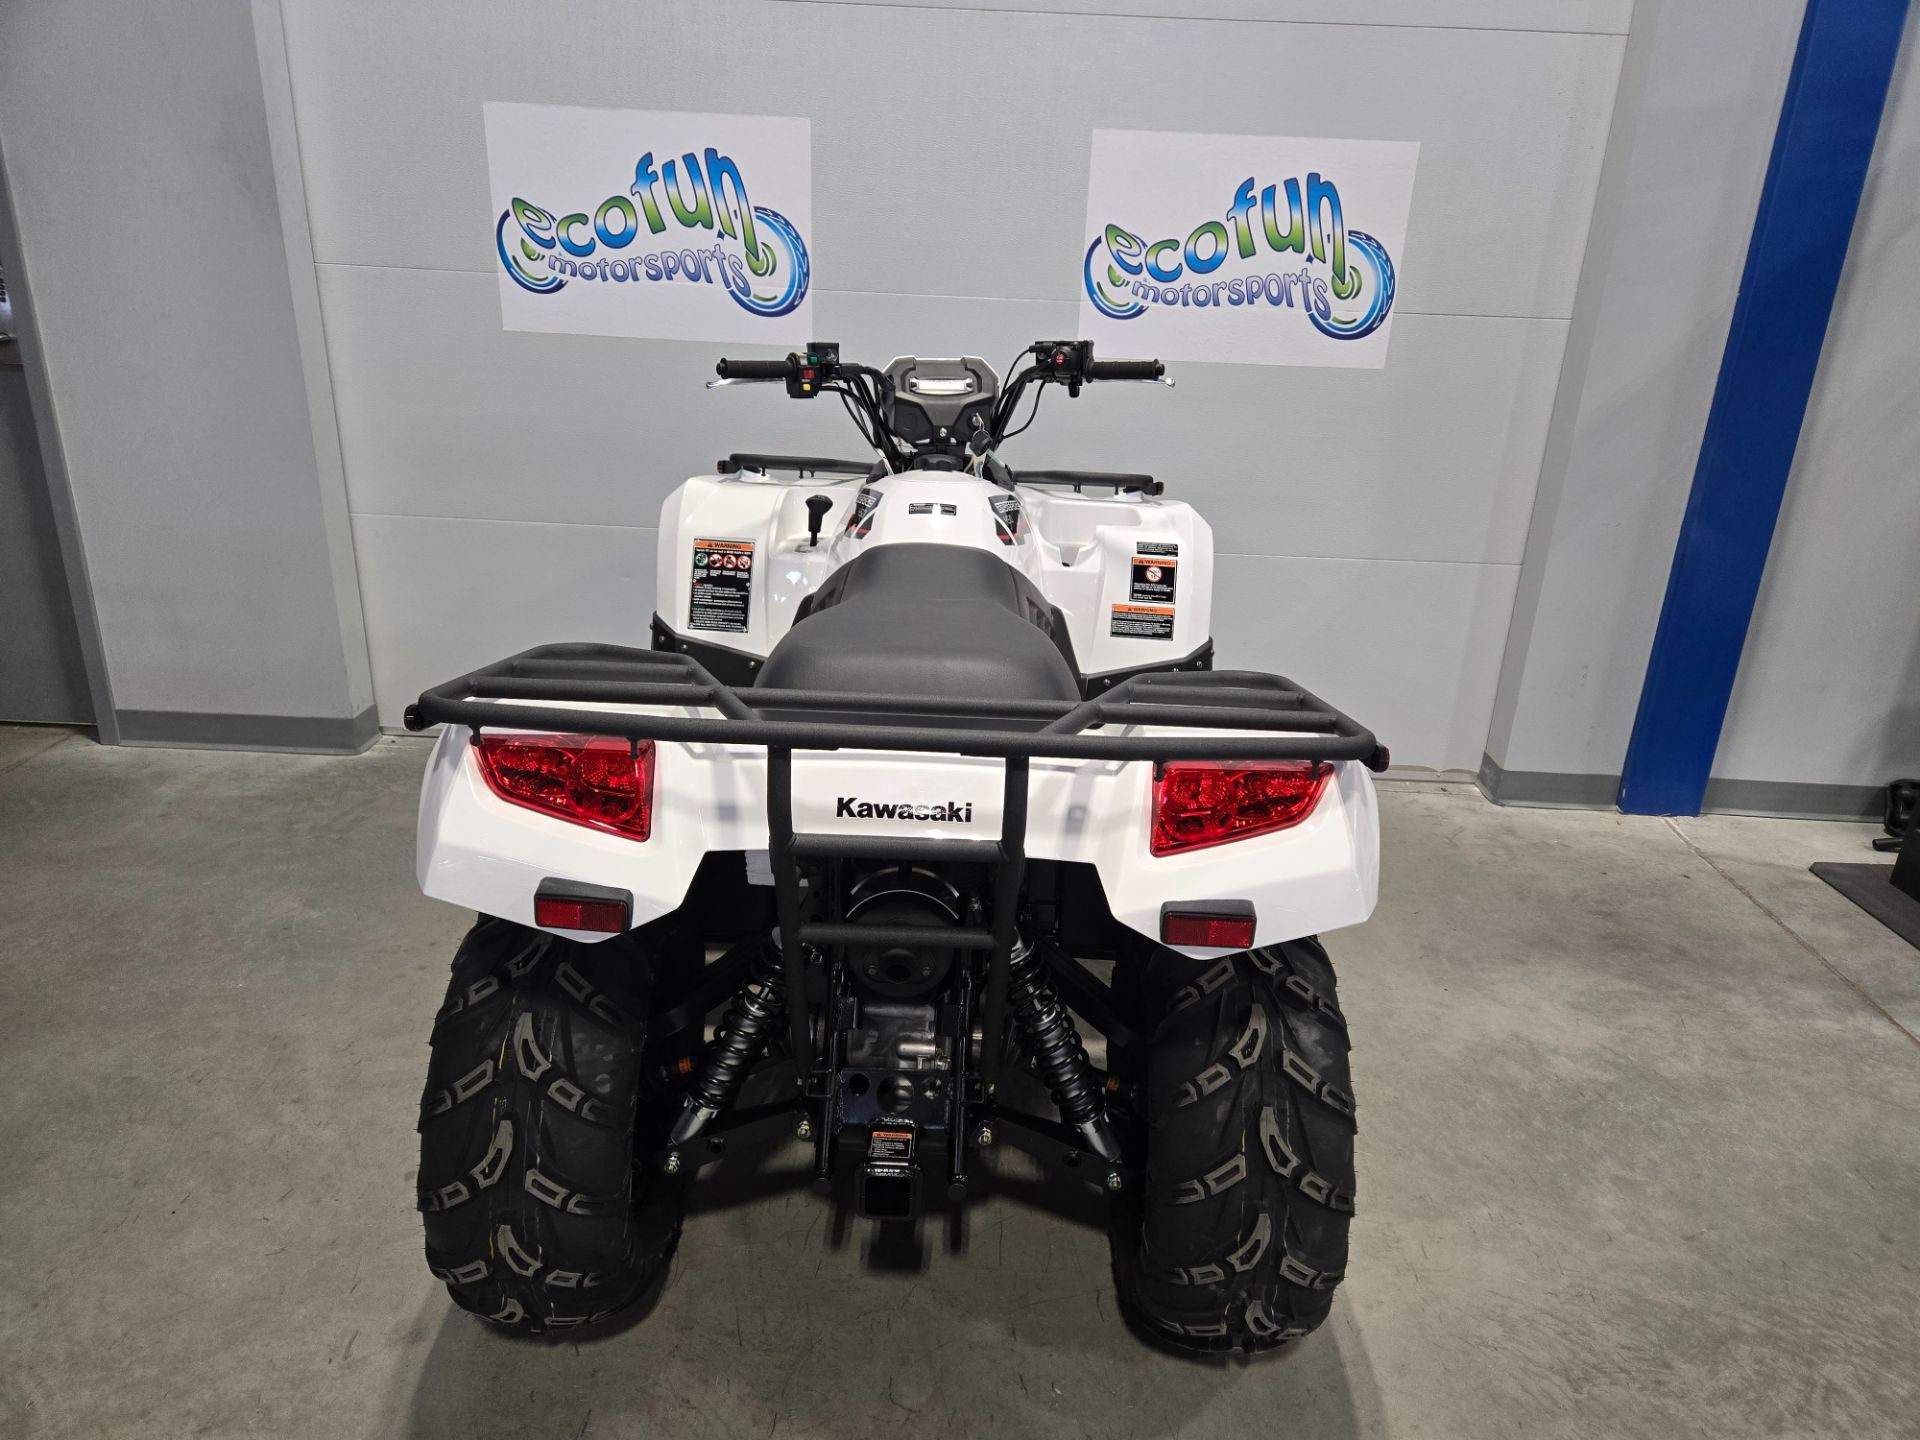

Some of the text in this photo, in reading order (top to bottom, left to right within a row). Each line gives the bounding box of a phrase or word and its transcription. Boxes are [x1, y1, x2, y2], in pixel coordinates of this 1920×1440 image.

[549, 243, 751, 298] motorsports
[1131, 267, 1332, 321] motorsports
[836, 797, 972, 823] Kawasaki
